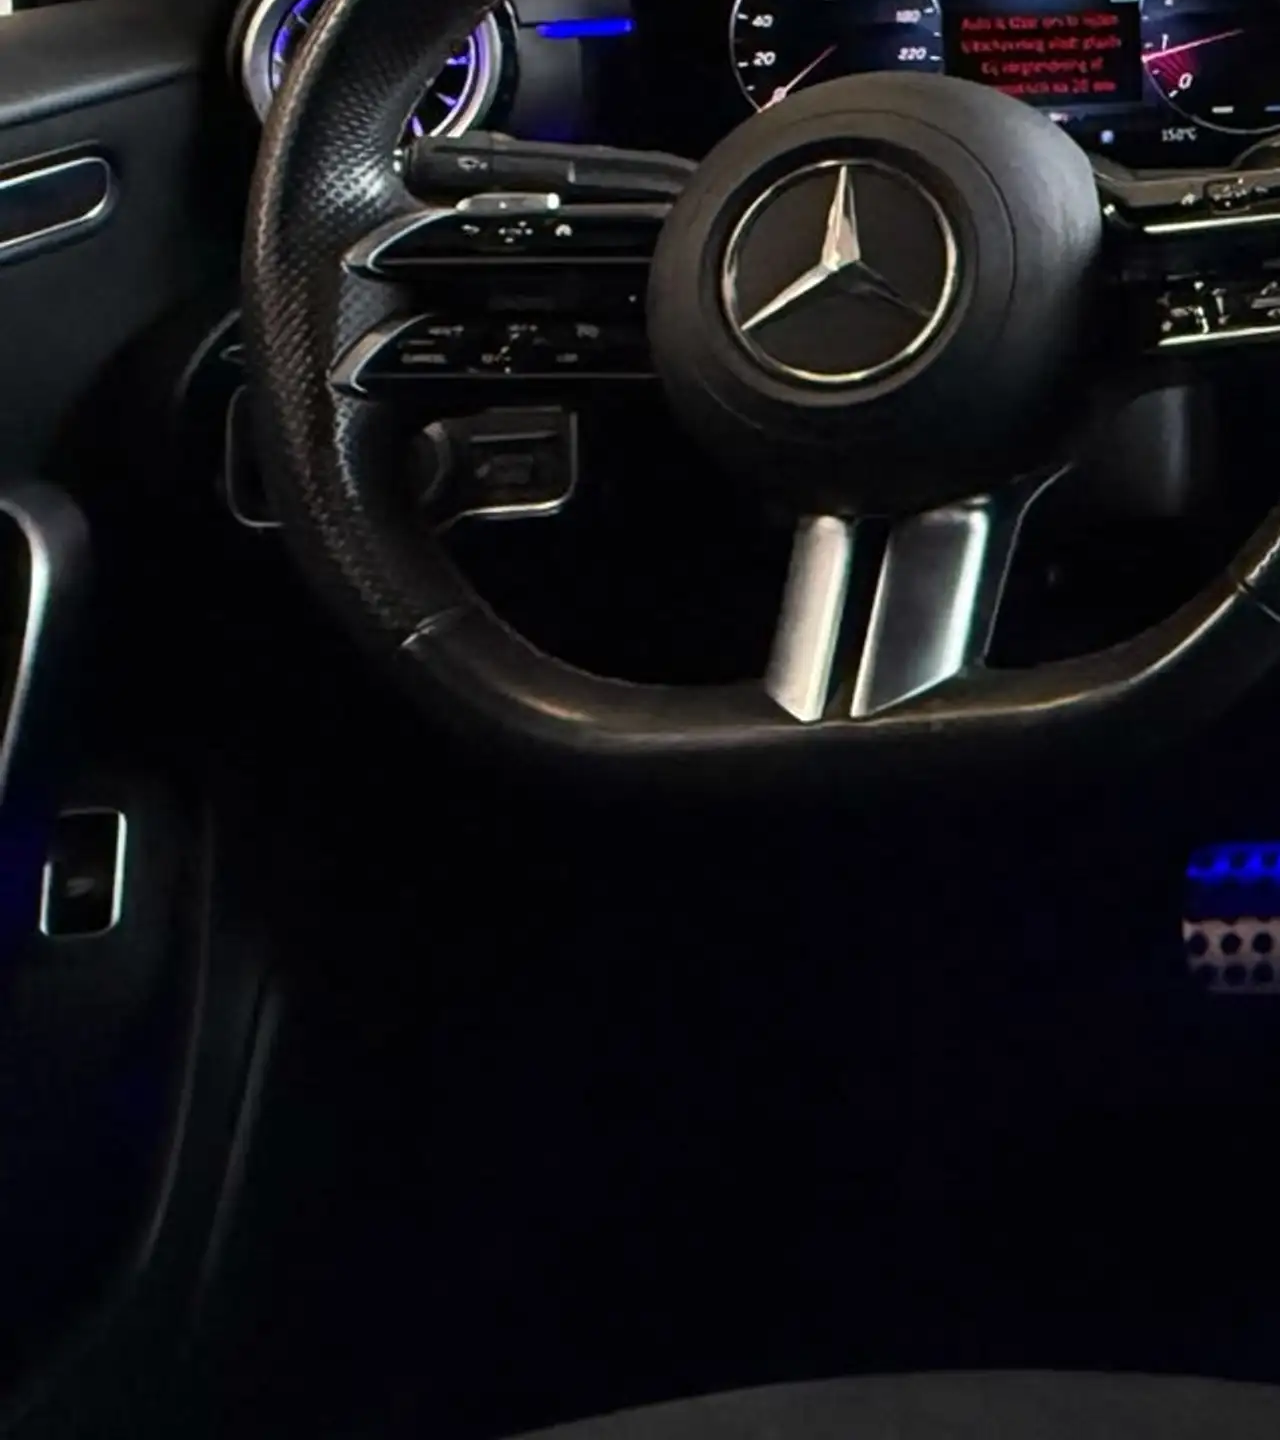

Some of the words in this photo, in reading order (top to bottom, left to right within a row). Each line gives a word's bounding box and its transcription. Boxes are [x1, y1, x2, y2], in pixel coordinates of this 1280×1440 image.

[752, 14, 773, 27] 40
[1161, 33, 1169, 51] 1
[753, 51, 776, 66] 20
[898, 47, 927, 60] 220
[1178, 73, 1193, 89] 0
